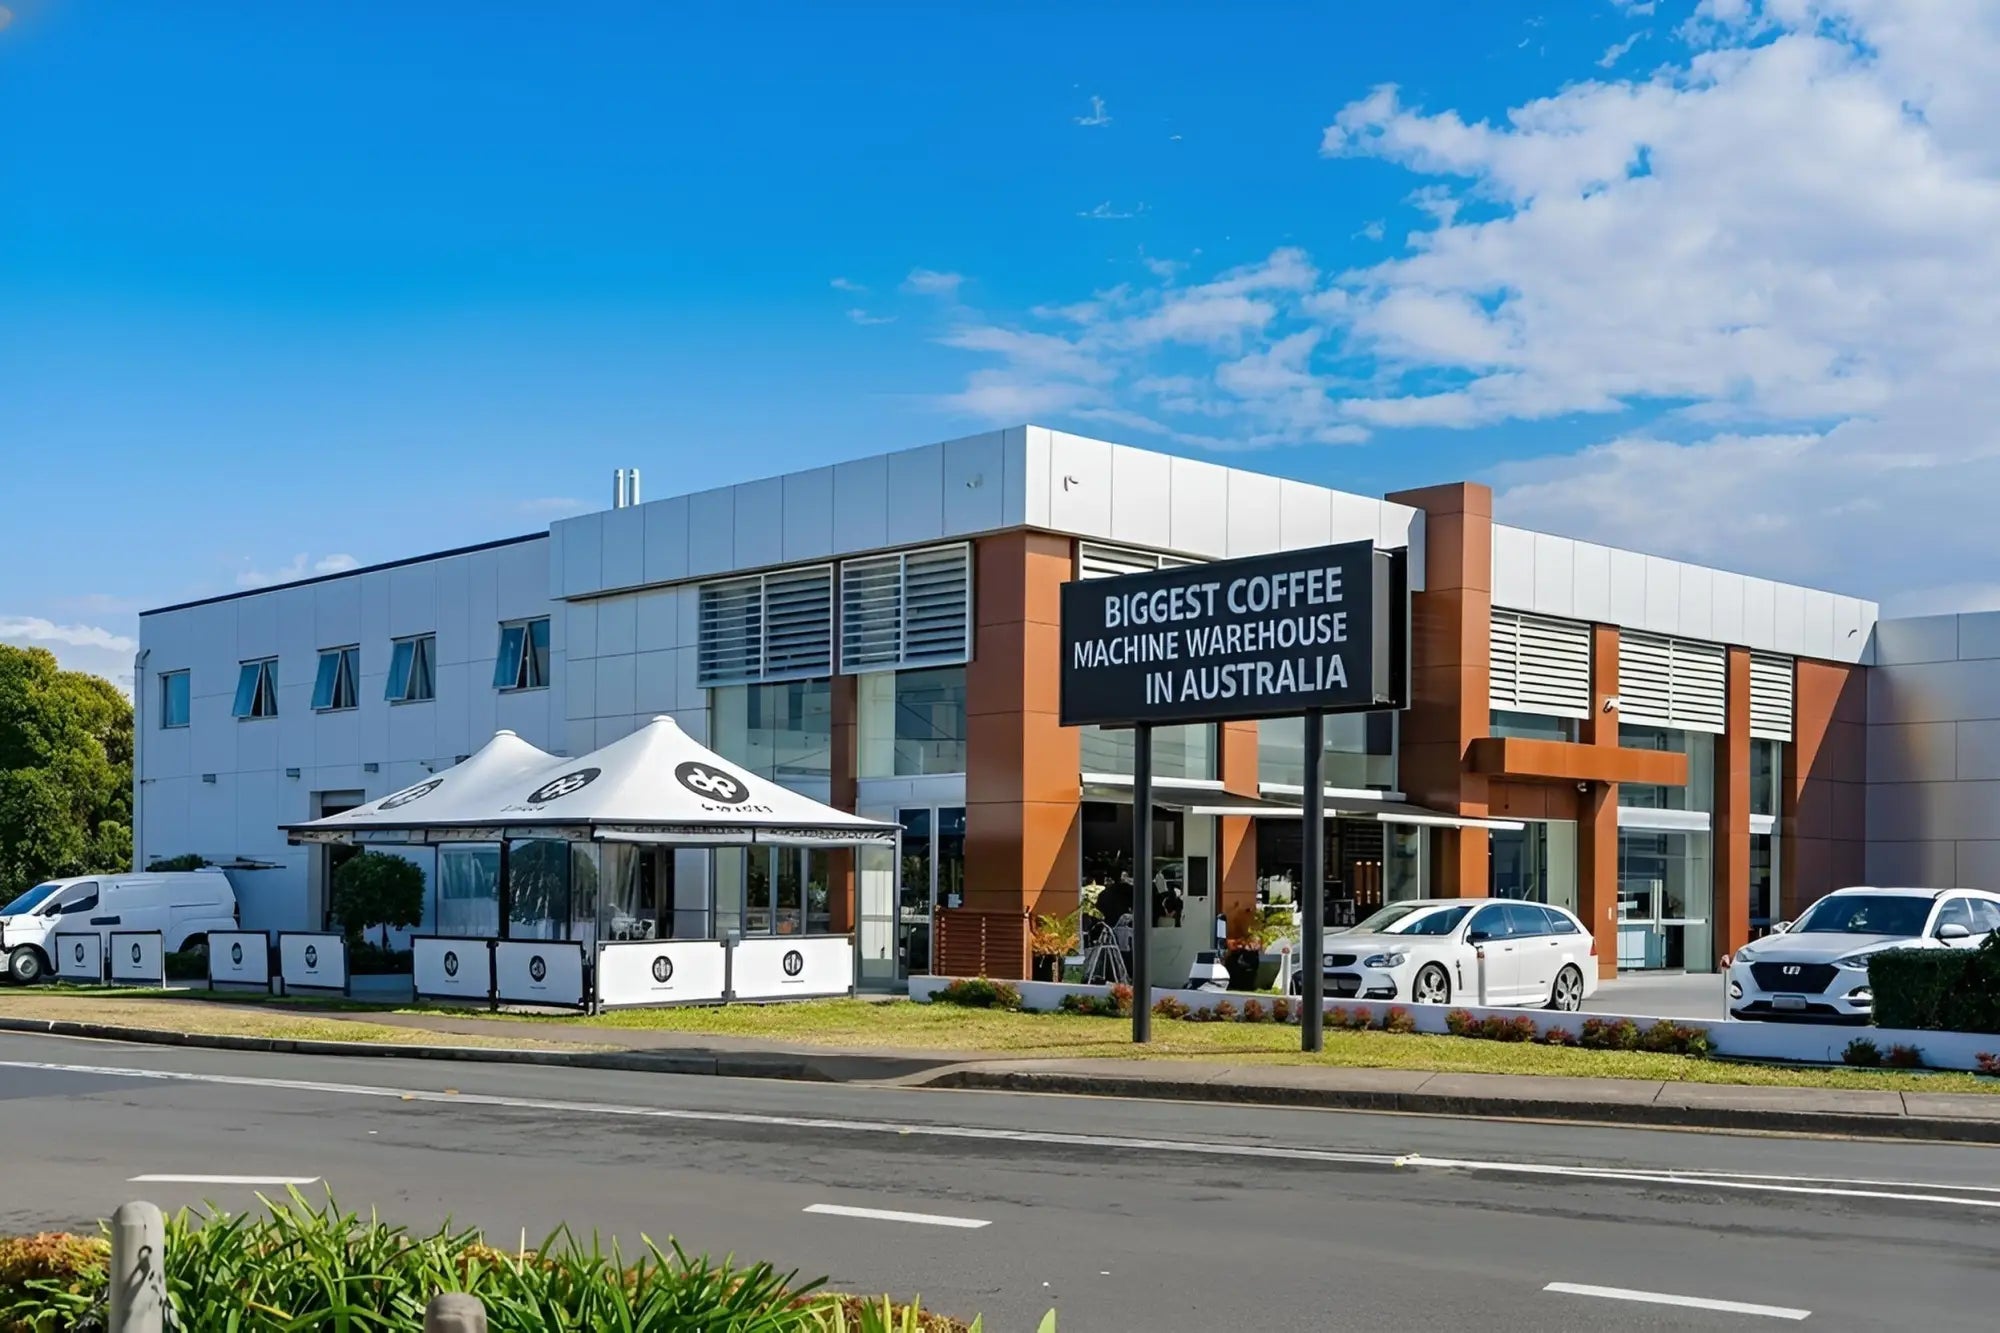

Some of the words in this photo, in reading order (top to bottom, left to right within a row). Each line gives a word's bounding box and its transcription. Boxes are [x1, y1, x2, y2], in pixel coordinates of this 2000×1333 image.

[1105, 582, 1221, 629] BIGGEST
[1227, 566, 1343, 614] COFFEE
[1074, 631, 1179, 669] MACHINE
[1185, 611, 1348, 658] WAREHOUSE
[1146, 670, 1173, 705] IN
[1179, 653, 1348, 703] AUSTRALIA
